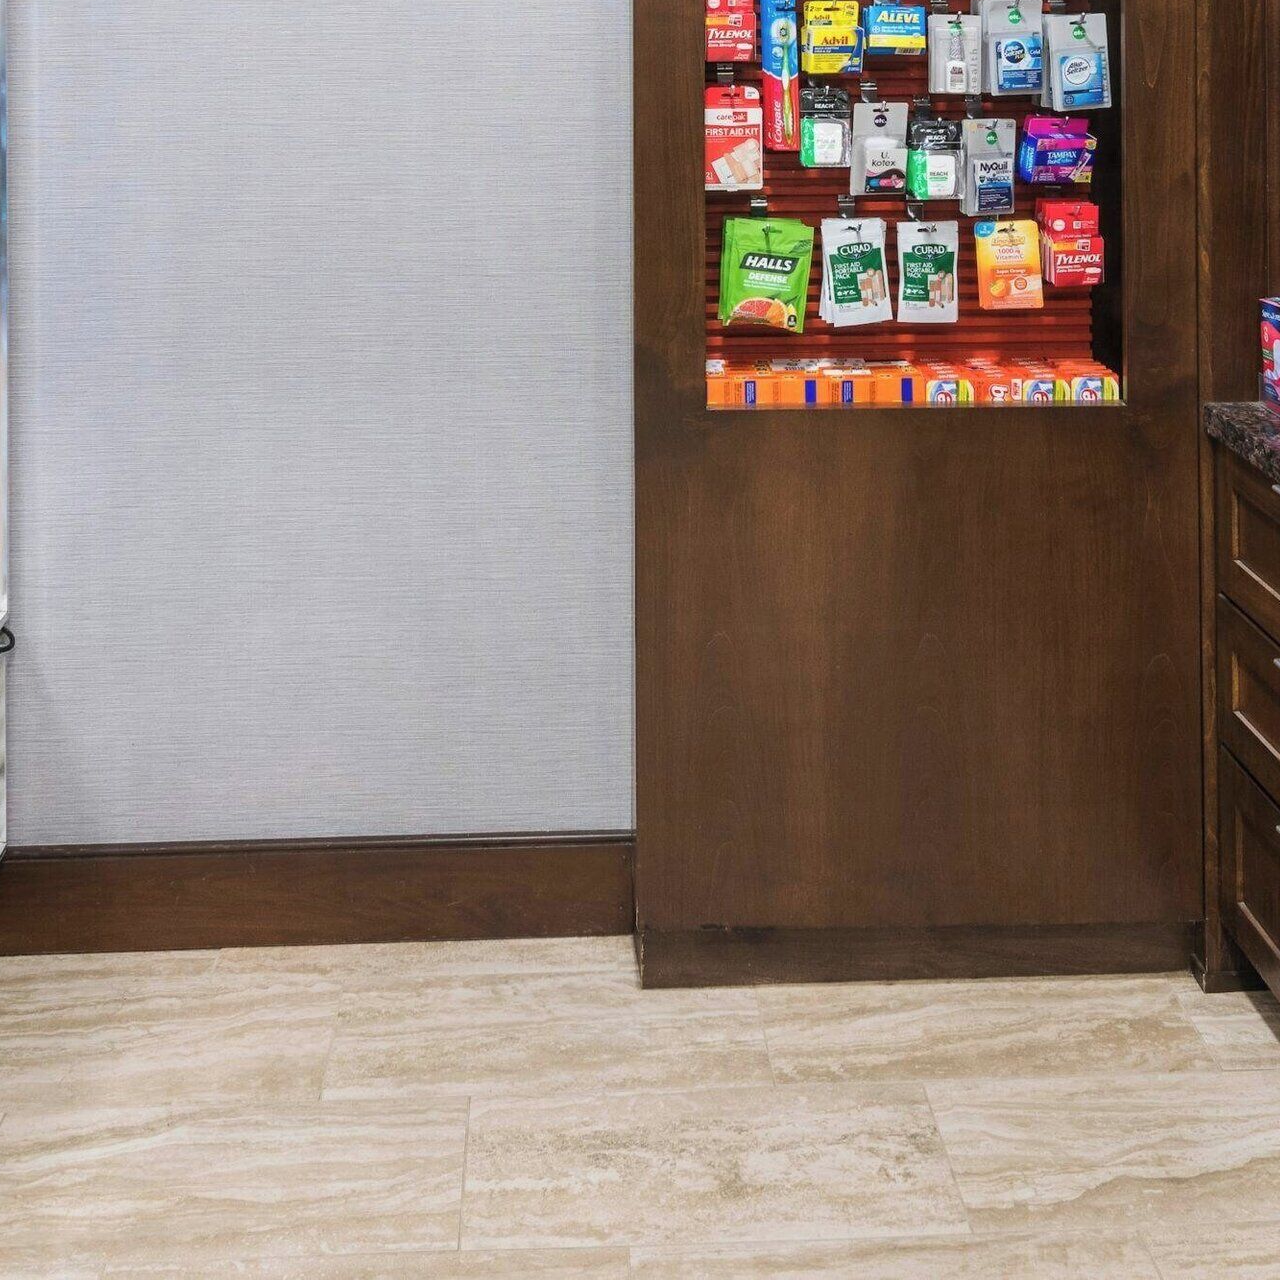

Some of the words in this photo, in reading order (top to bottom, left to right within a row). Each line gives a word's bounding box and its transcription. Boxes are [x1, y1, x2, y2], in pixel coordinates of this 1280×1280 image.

[876, 10, 920, 24] ALEVE
[707, 28, 753, 40] TYLENOL
[821, 36, 848, 46] Advil
[1066, 64, 1090, 77] Seltzer
[773, 101, 784, 143] Colgate
[705, 128, 728, 136] FIRST
[729, 128, 743, 136] AID
[743, 128, 760, 136] KIT
[1047, 151, 1077, 159] TAMPAX
[980, 162, 1008, 174] NyQuil
[840, 243, 871, 255] CURAD
[915, 245, 945, 255] CURAD
[745, 255, 793, 271] HALLS
[1055, 253, 1102, 265] TYLENOL
[748, 272, 788, 284] DEFENSE
